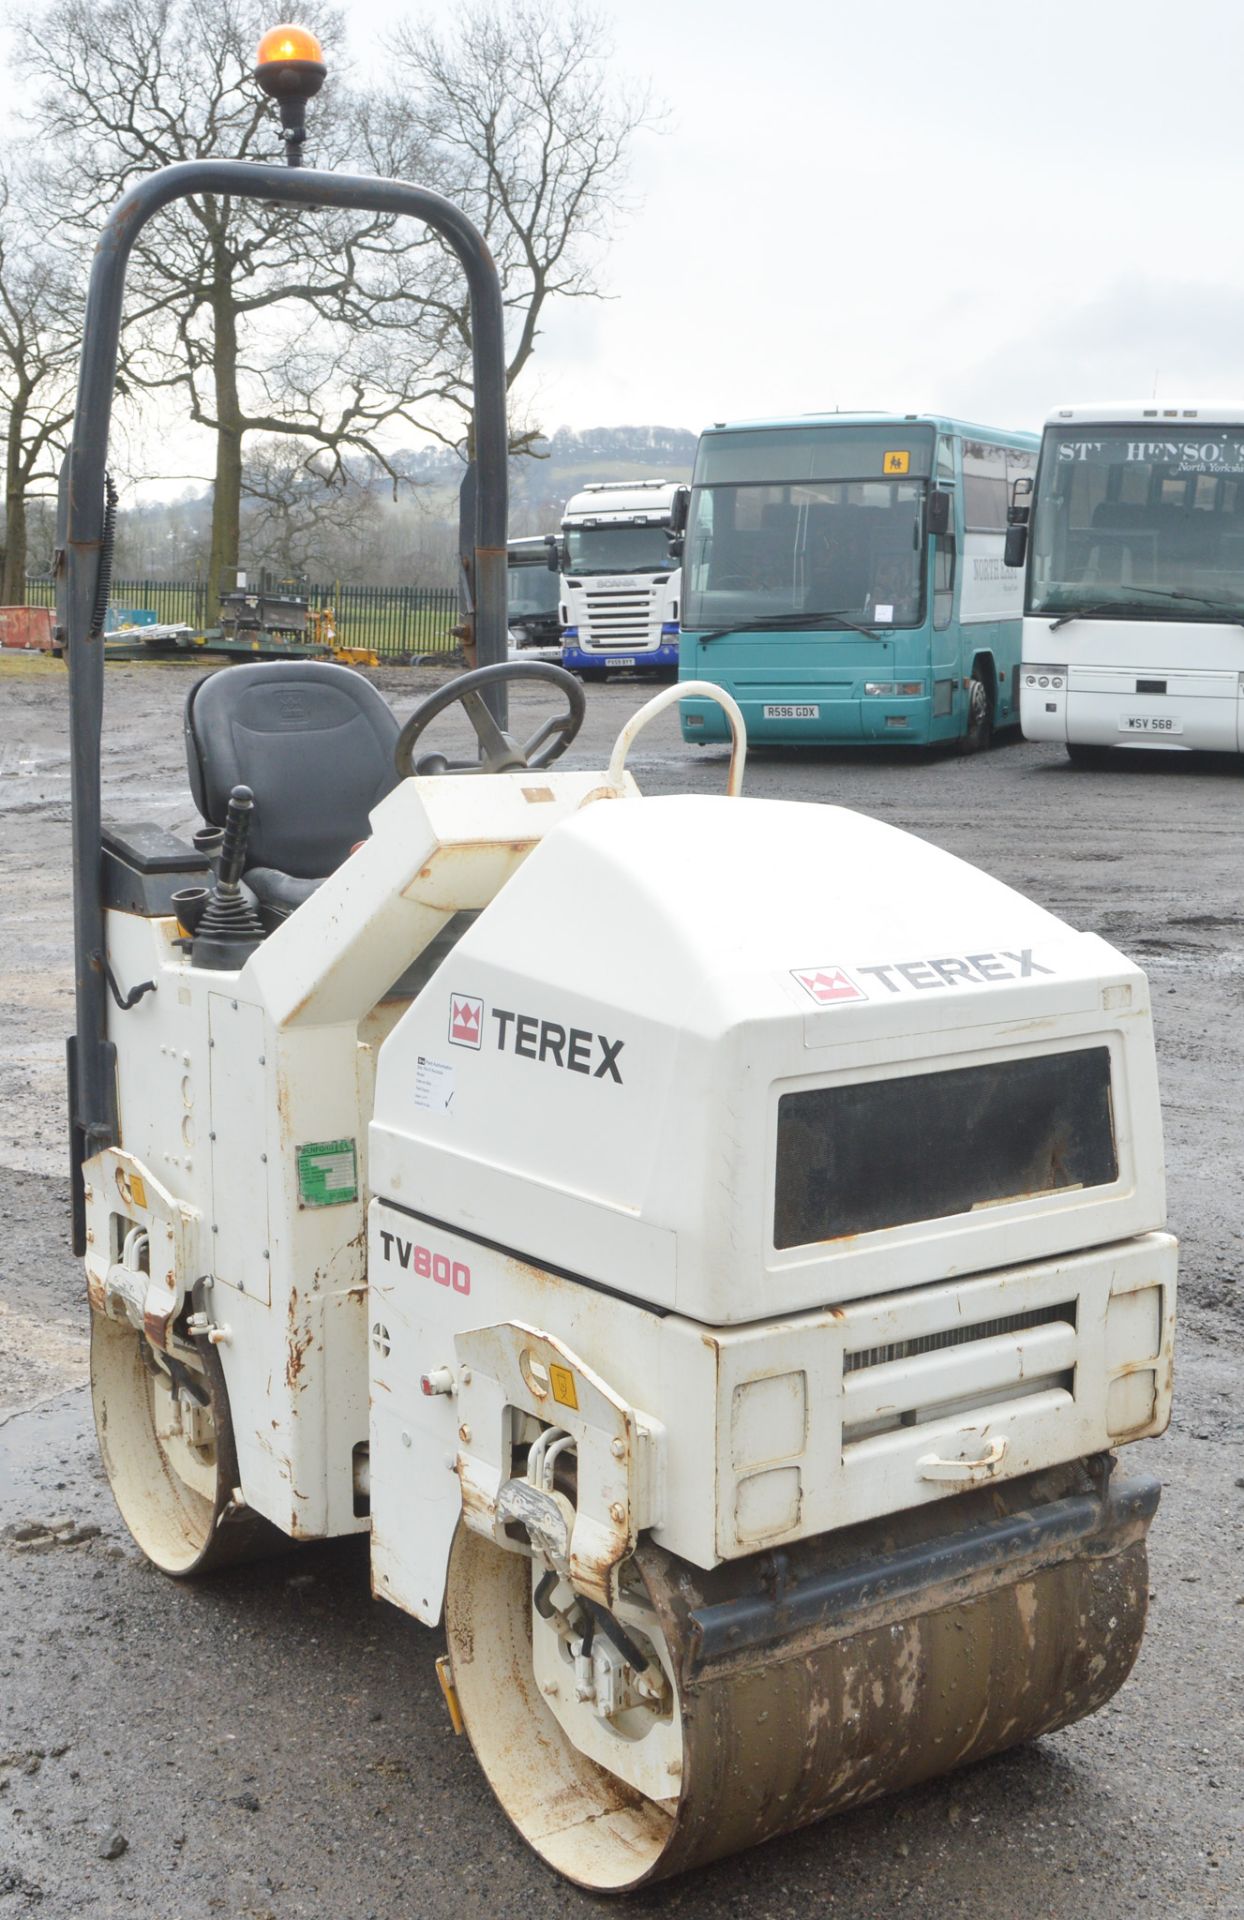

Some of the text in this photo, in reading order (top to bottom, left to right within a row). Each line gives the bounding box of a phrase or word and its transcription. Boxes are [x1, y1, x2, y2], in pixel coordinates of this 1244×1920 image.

[1178, 462, 1206, 472] North
[768, 707, 815, 717] R596 GDX
[1128, 718, 1172, 729] WSV 568
[855, 949, 1057, 993] TEREX
[491, 1007, 625, 1085] TEREX
[380, 1230, 471, 1297] TV800
